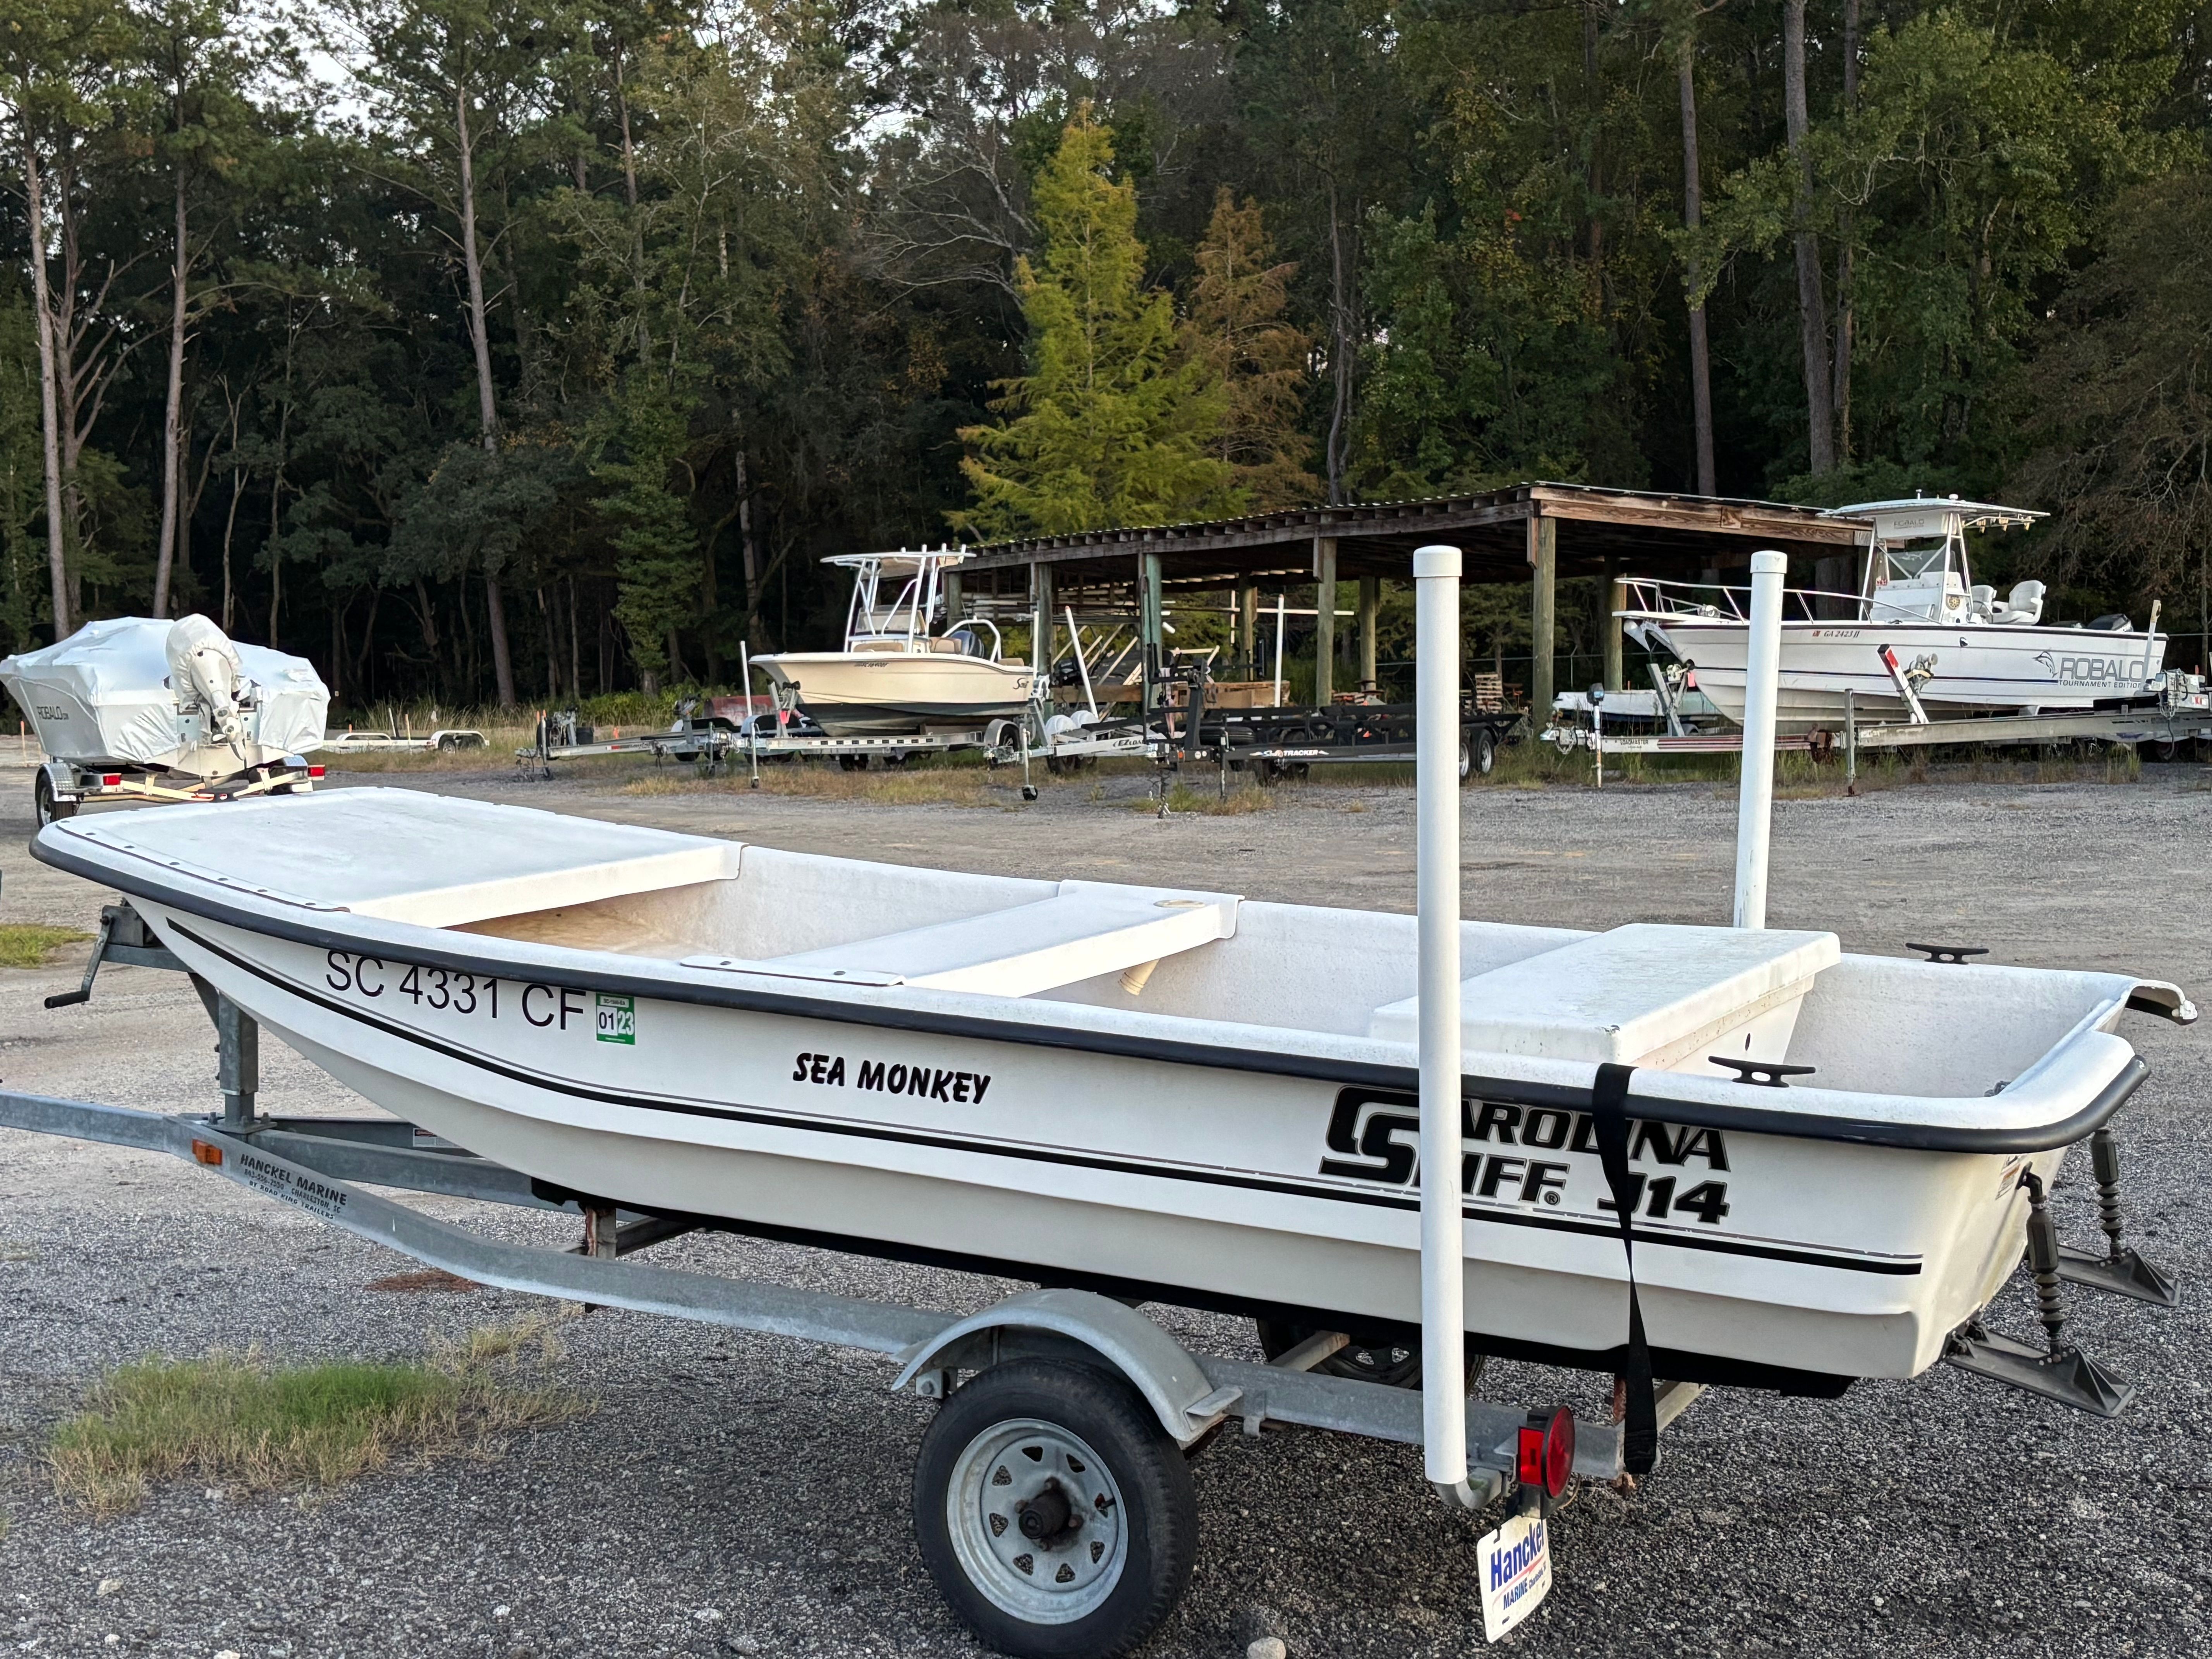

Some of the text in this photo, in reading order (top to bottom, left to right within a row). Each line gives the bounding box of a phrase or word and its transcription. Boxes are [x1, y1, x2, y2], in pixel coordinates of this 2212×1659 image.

[2059, 658, 2144, 682] ROBALO
[326, 950, 586, 1030] SC 4331 CF
[599, 1010, 634, 1036] 01 23
[793, 1053, 991, 1104] SEA MONKEY
[1325, 1084, 1731, 1172] CROLNA
[240, 1154, 347, 1206] HANCKEL MARINE
[260, 1185, 278, 1196] ROAD
[280, 1194, 298, 1204] KING
[302, 1200, 335, 1219] TRAILERS
[1491, 1522, 1544, 1592] Hanckel
[1503, 1577, 1528, 1610] MARINE
